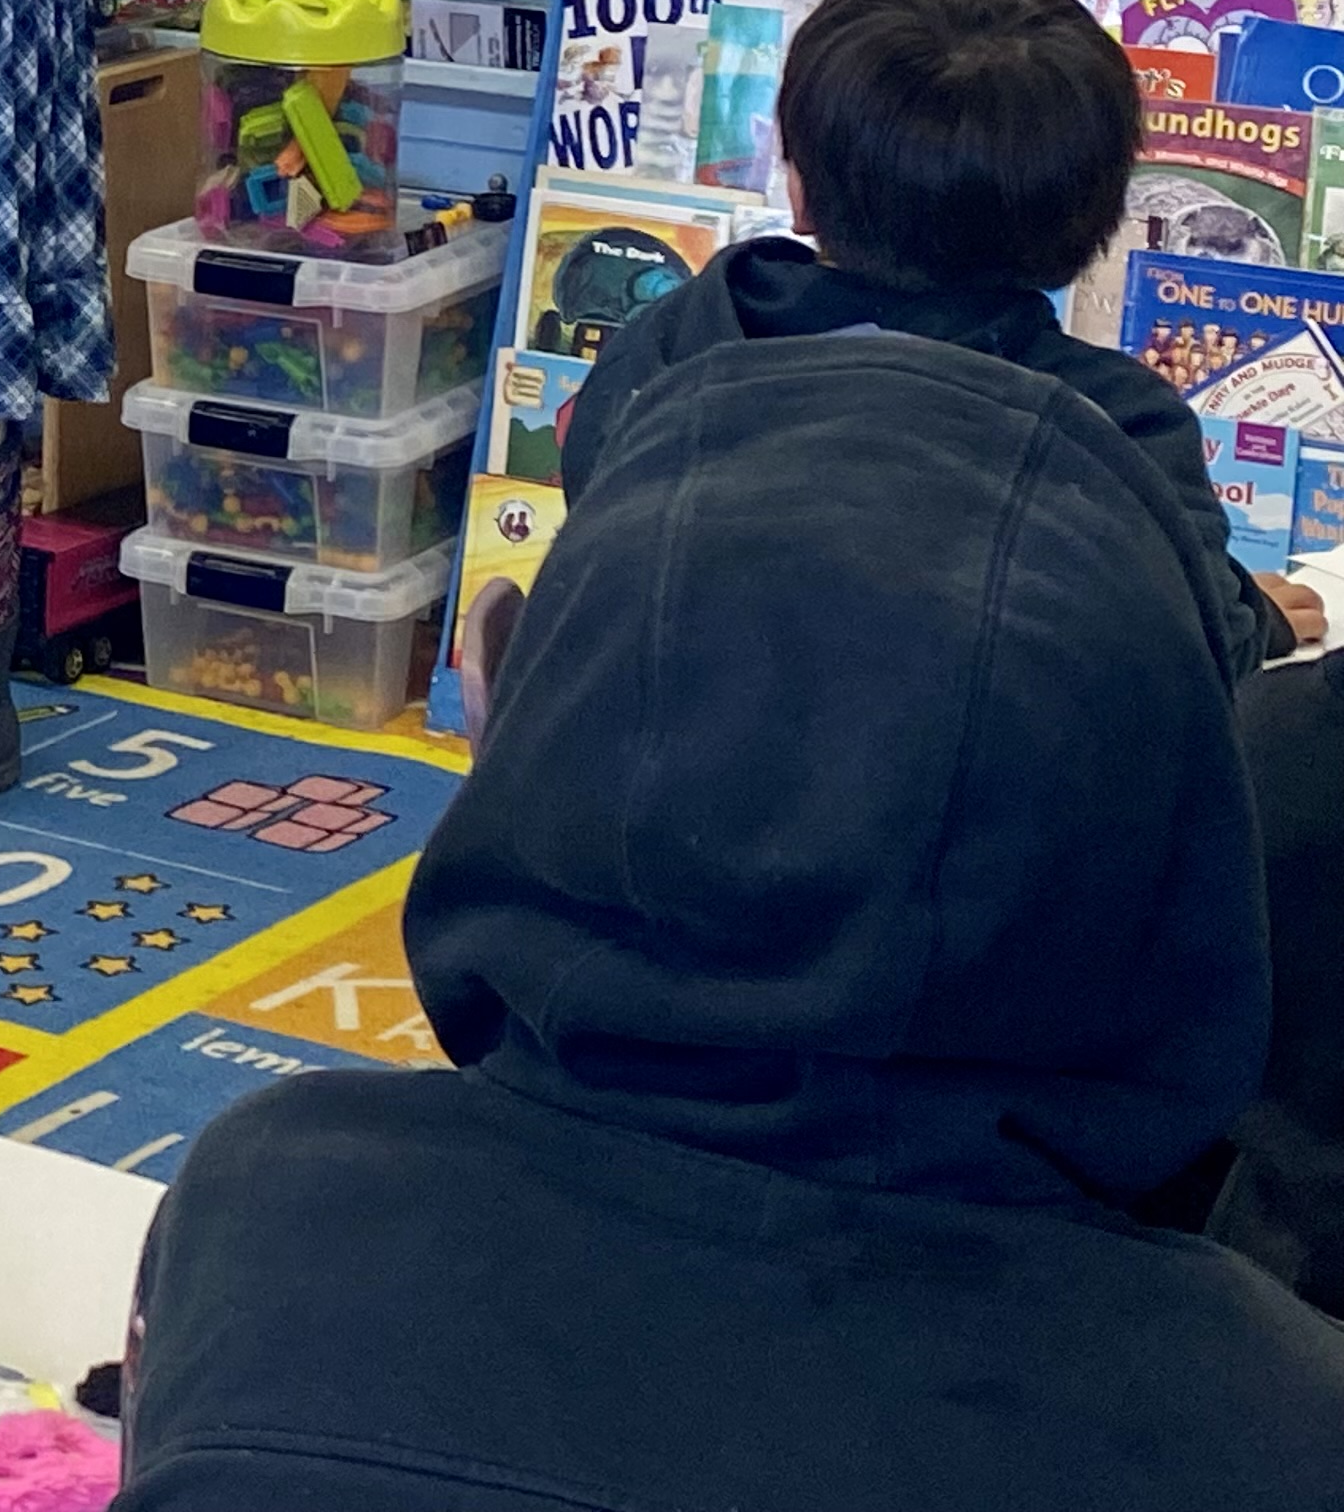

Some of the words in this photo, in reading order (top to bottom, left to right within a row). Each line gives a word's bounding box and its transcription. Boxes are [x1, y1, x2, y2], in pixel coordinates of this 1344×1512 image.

[591, 240, 623, 259] The
[625, 244, 667, 265] Dark
[1157, 281, 1216, 309] ONE
[1240, 291, 1298, 320] ONE
[1231, 366, 1258, 388] AND
[68, 729, 216, 780] 5
